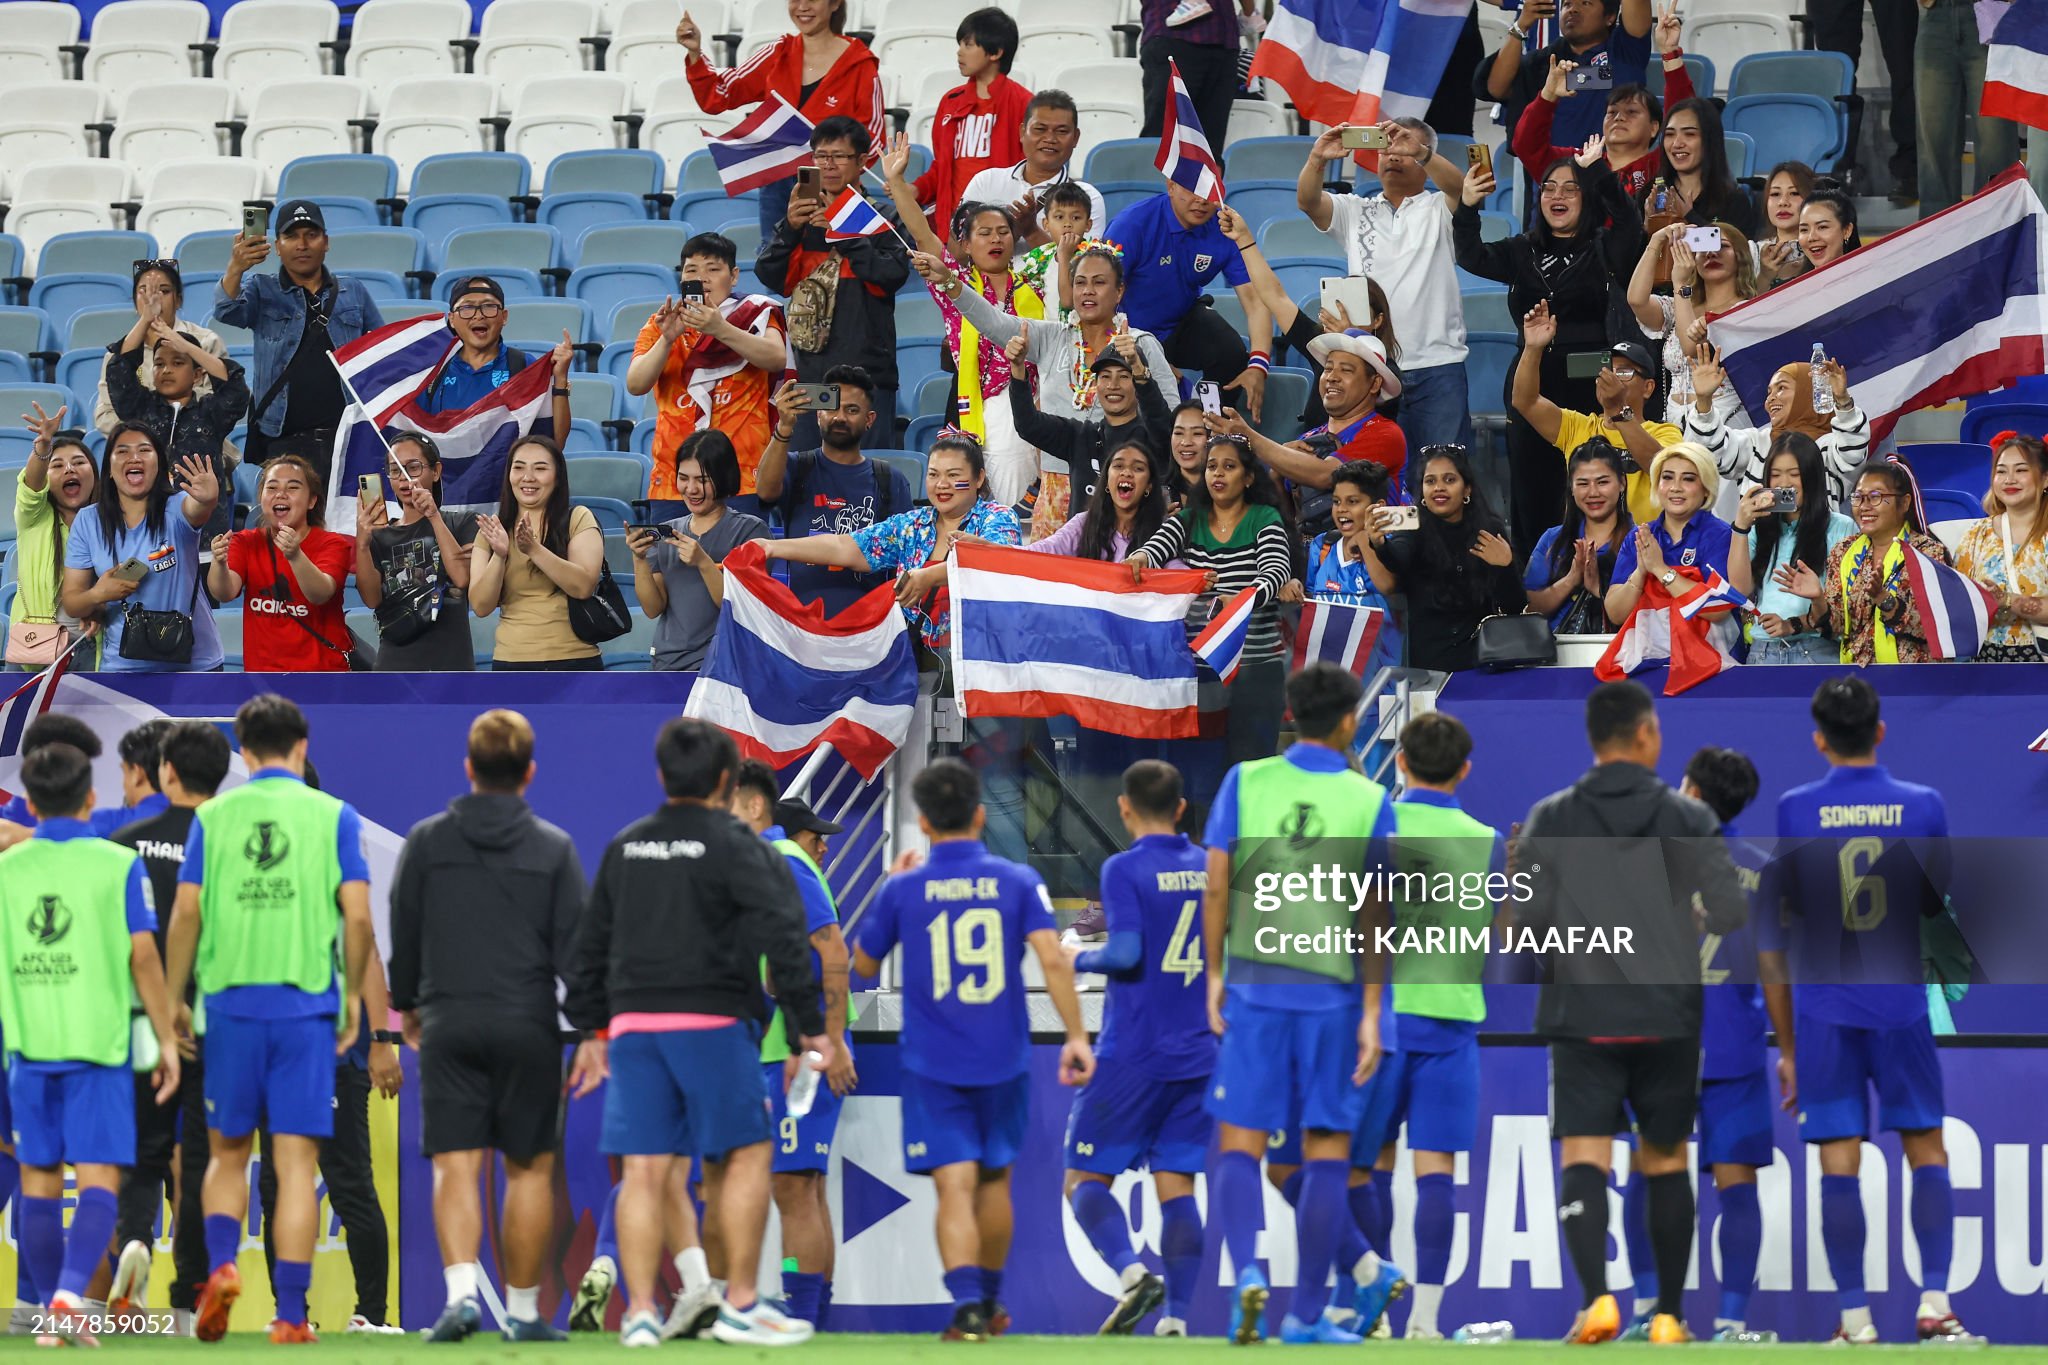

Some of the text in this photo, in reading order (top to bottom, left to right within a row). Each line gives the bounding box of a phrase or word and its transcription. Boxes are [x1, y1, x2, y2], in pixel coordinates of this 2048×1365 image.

[153, 556, 176, 572] EAGLE
[249, 597, 309, 617] adidas
[1819, 804, 1904, 829] SONGWUT
[1838, 836, 1888, 931] 6
[925, 907, 1006, 1004] 19
[1160, 899, 1204, 988] 4
[779, 1116, 798, 1155] 9
